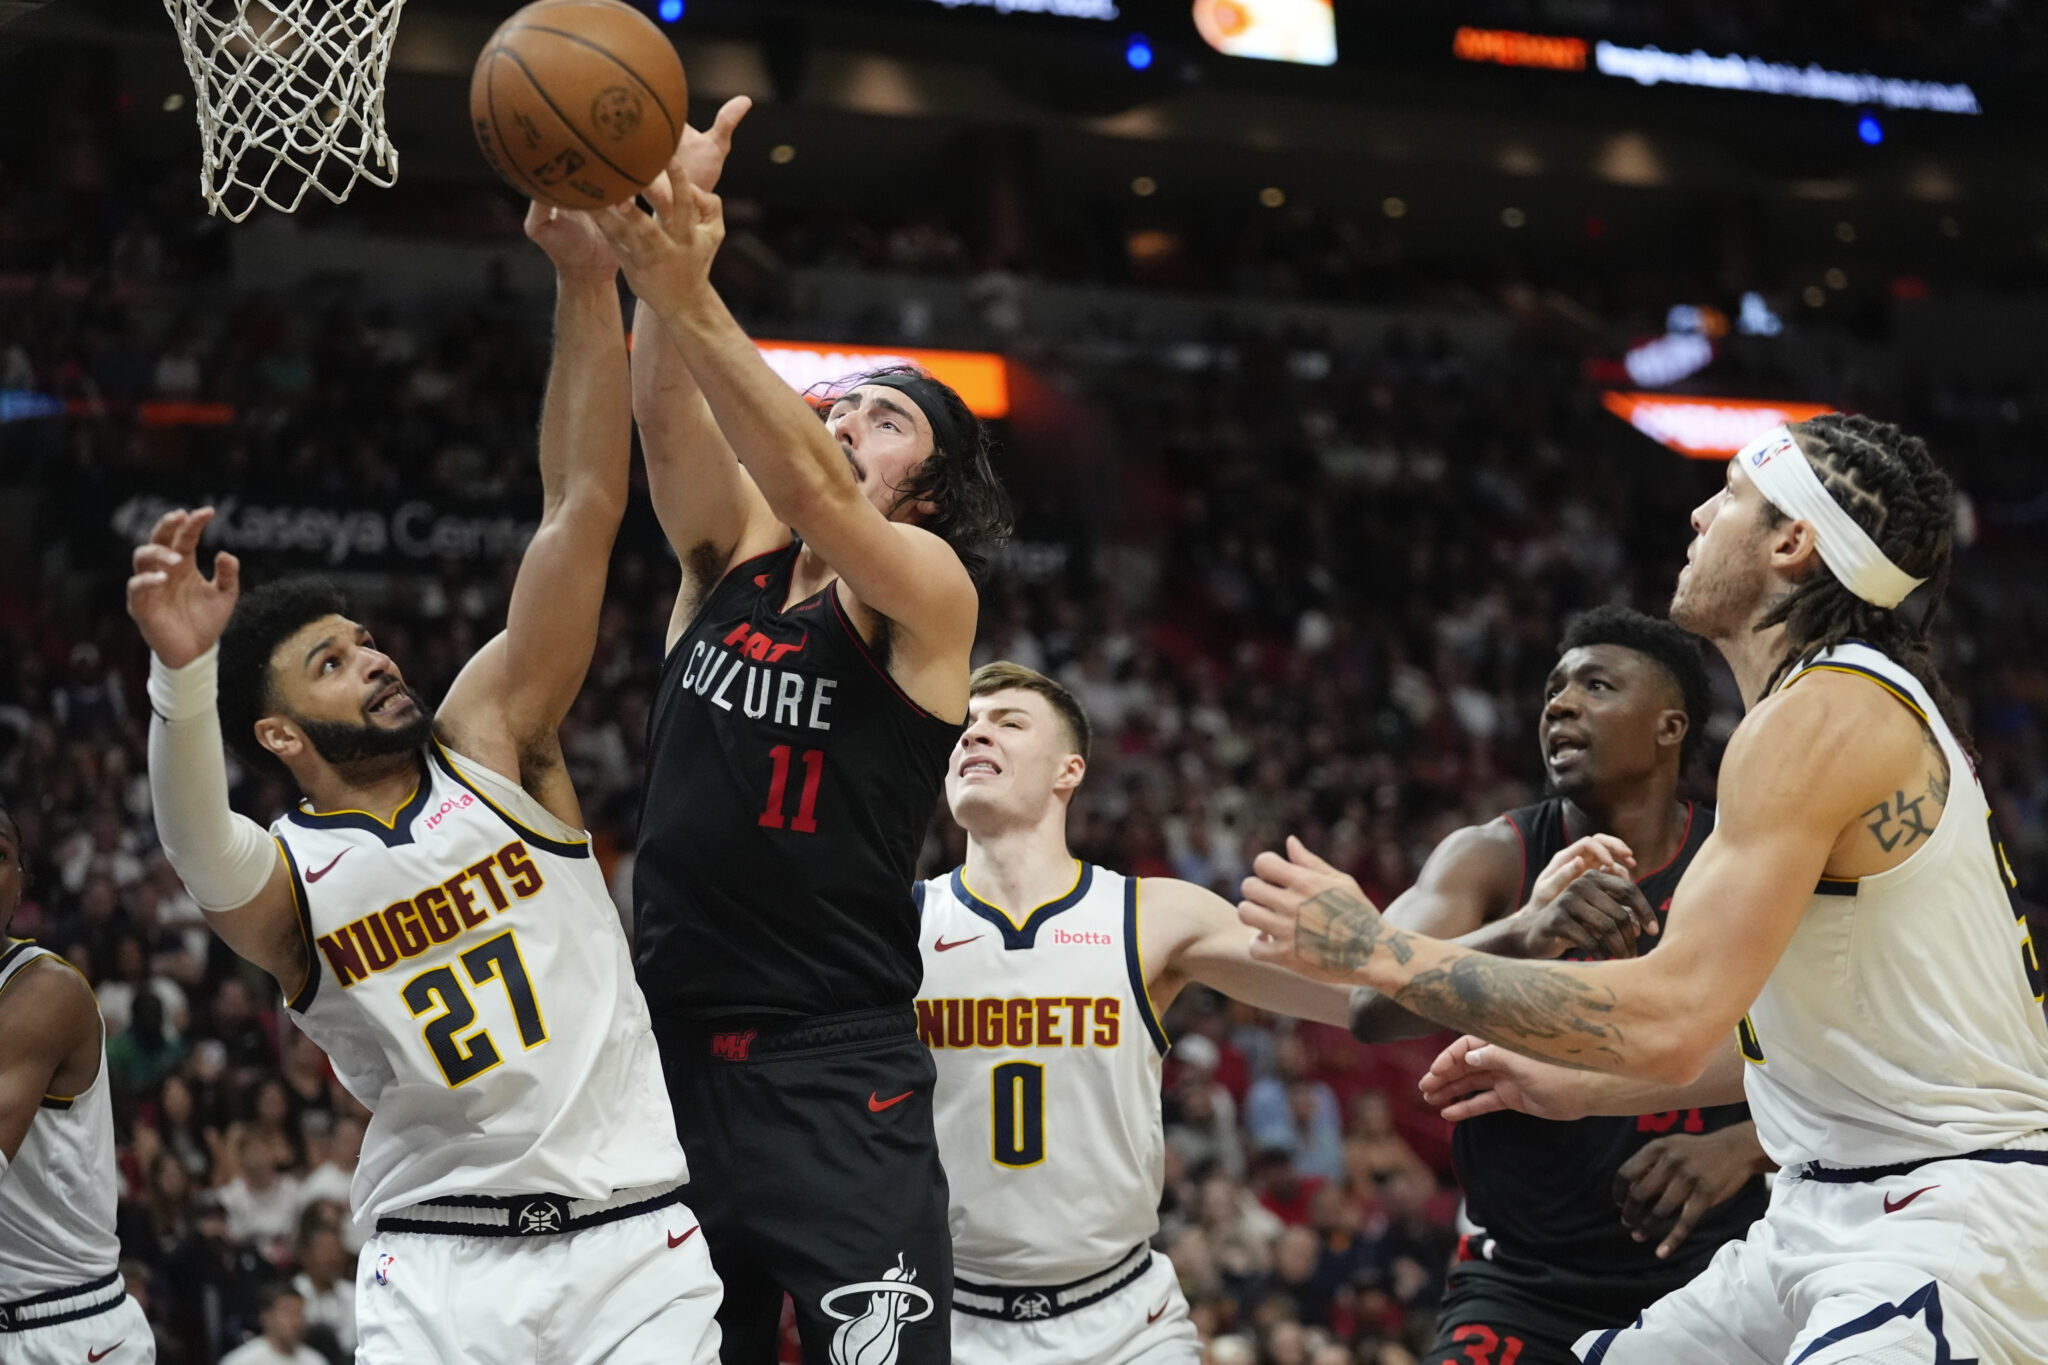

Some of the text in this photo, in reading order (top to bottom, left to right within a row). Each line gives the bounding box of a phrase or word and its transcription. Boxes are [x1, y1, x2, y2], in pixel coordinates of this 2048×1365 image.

[203, 496, 537, 565] Kaseya Cente
[758, 744, 824, 833] 11
[1862, 790, 1933, 853] 改
[317, 839, 545, 989] NUGGETS
[1053, 929, 1111, 945] ibotta
[400, 929, 549, 1090] 27
[915, 997, 1121, 1049] NUGGETS
[991, 1059, 1046, 1169] 0
